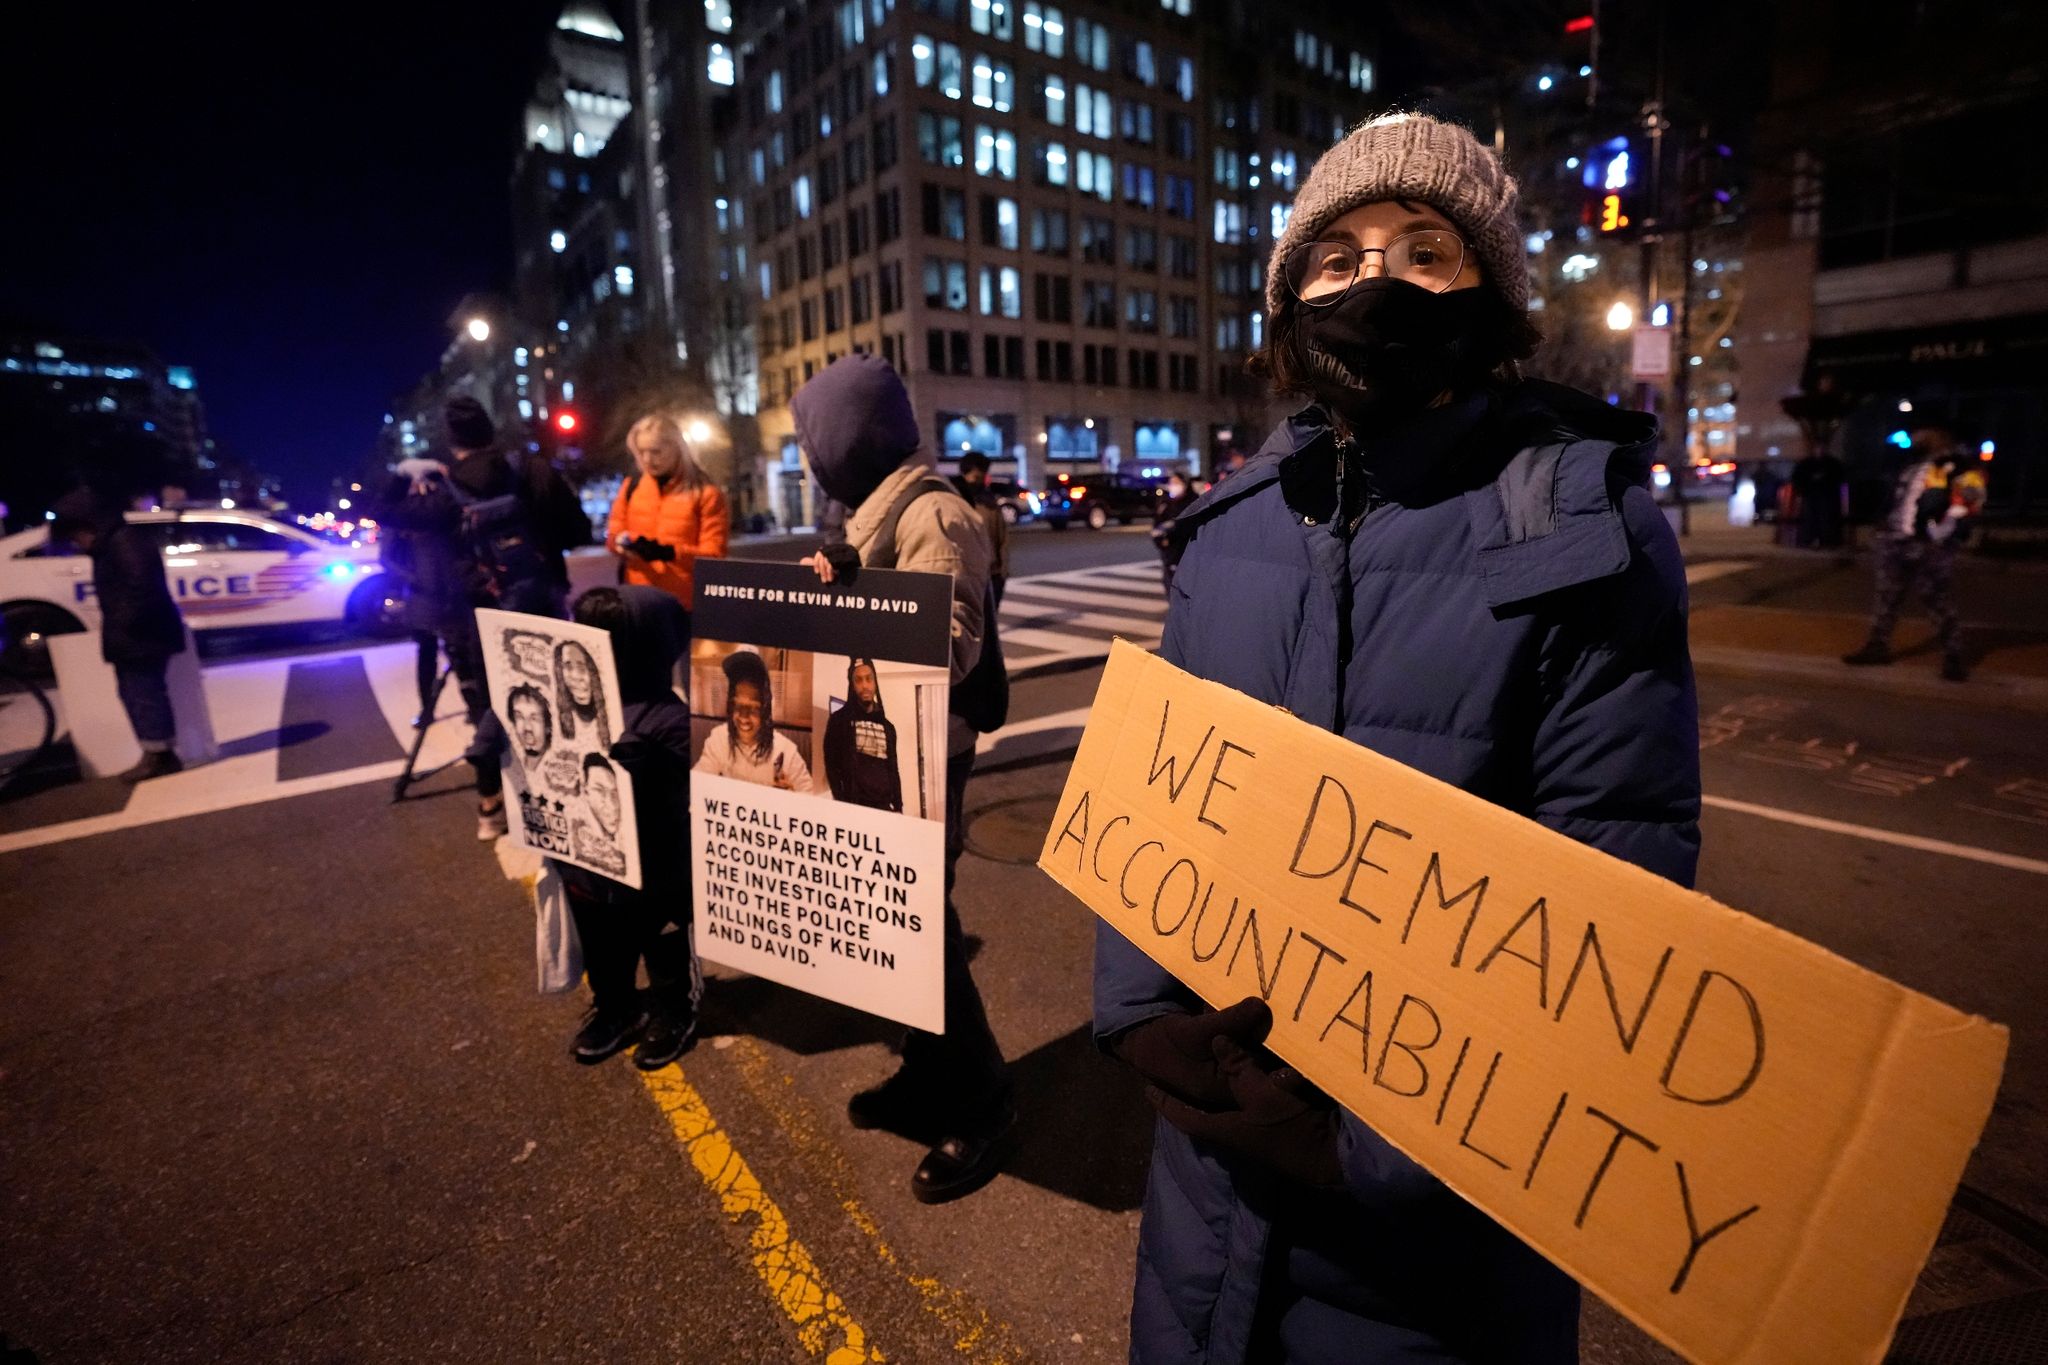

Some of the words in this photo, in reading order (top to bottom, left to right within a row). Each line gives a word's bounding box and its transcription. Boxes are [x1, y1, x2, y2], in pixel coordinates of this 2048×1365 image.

[75, 576, 252, 602] PICE
[704, 584, 754, 600] JUSTICE
[758, 588, 784, 602] FOR
[788, 591, 831, 606] KEVIN
[836, 595, 866, 610] AND
[871, 598, 918, 614] DAVID
[524, 828, 570, 855] NOW
[704, 798, 730, 818] WE
[737, 806, 782, 831] CALL
[789, 818, 827, 841] FOR
[835, 828, 886, 855] FULL
[704, 819, 863, 872] TRANSPARENCY
[871, 860, 917, 884] AND
[705, 841, 876, 898] ACCOUNTABILITY
[885, 885, 907, 906] IN
[705, 860, 739, 883] THE
[746, 871, 922, 932] INVESTIGATIONS
[1147, 700, 1256, 835] WE
[1288, 773, 1767, 1106] DEMAND
[706, 881, 748, 906] INTO
[754, 894, 790, 918] THE
[797, 907, 870, 941] POLICE
[707, 901, 792, 939] KILLINGS
[799, 929, 823, 948] OF
[831, 937, 895, 970] KEVIN
[709, 921, 745, 945] AND
[751, 934, 816, 968] DAVID.
[1053, 791, 1759, 1295] ACCOUNTABILITY
